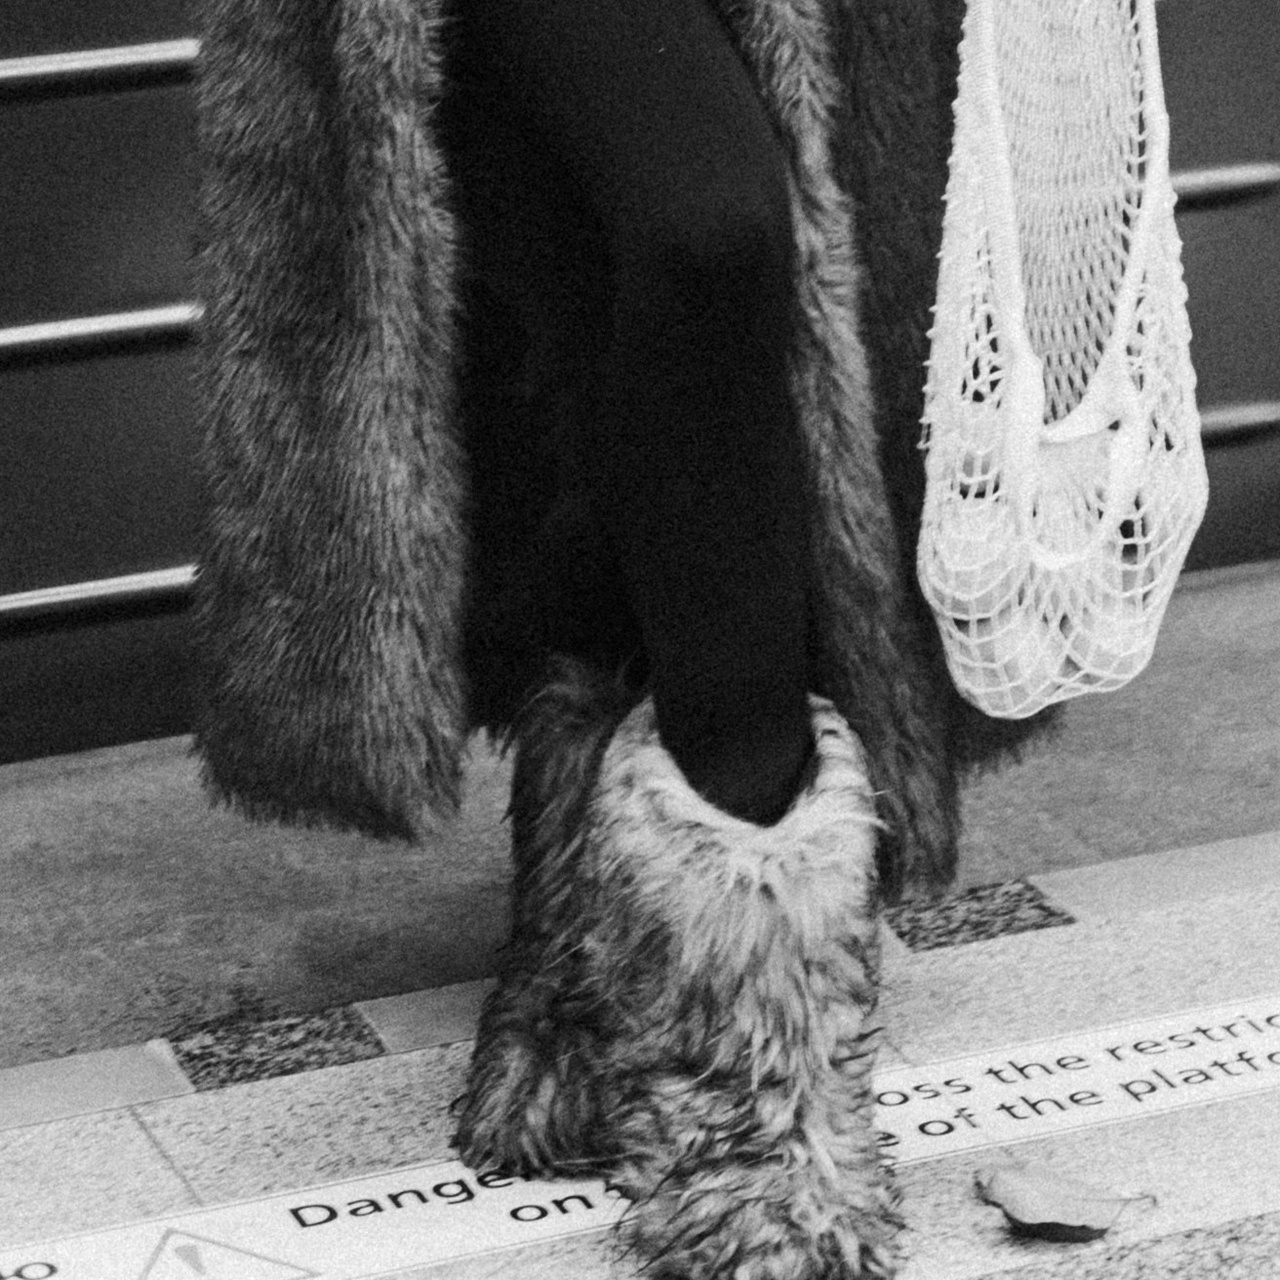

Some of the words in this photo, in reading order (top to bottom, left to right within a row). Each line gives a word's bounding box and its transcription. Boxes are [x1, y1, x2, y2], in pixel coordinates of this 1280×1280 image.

[289, 1170, 515, 1228] Dange
[876, 1077, 972, 1107] oss
[985, 1055, 1091, 1084] the
[509, 1193, 595, 1222] on
[918, 1107, 978, 1136] of
[996, 1090, 1105, 1120] the
